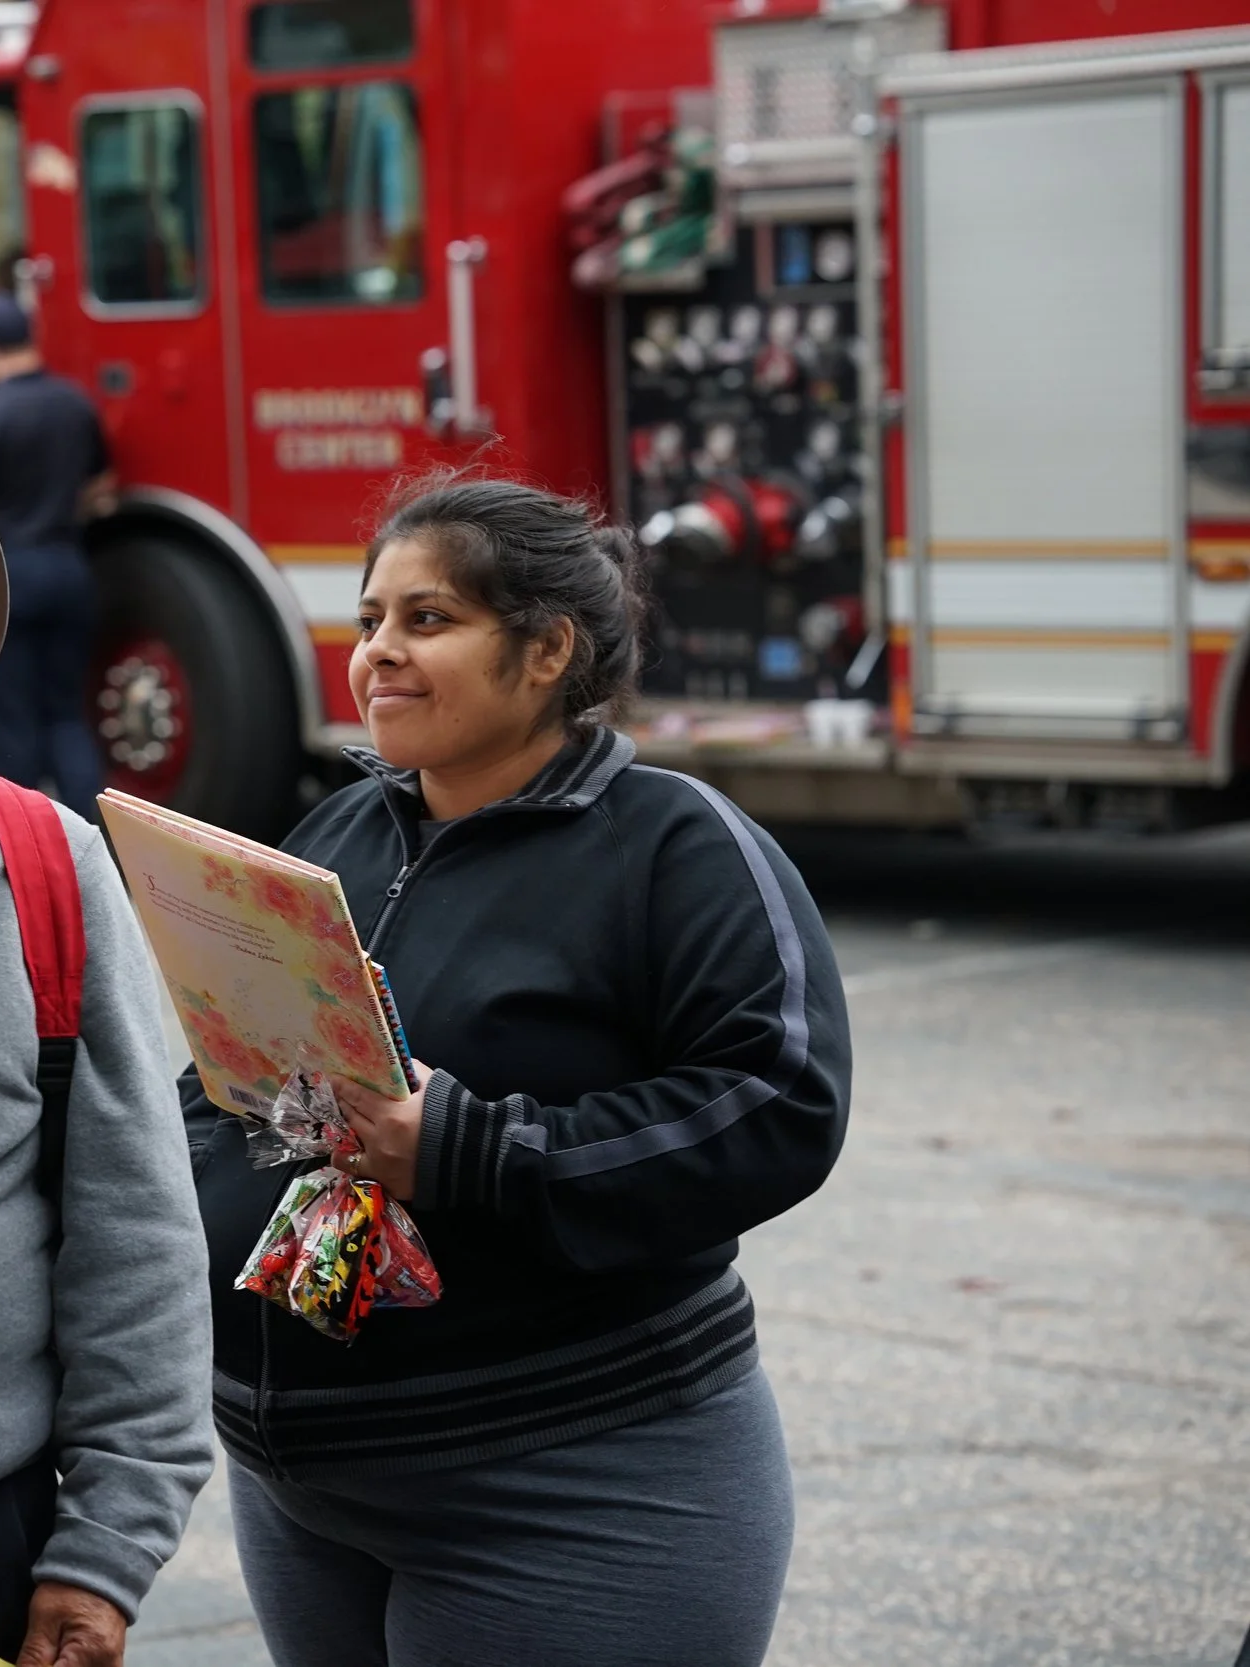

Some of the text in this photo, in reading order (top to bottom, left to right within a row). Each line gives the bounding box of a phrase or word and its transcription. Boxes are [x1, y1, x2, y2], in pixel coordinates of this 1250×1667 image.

[254, 388, 421, 429] BROOKLYN
[276, 431, 401, 470] CENTER
[367, 994, 385, 1032] Tomatoes
[382, 1041, 398, 1065] Neela
